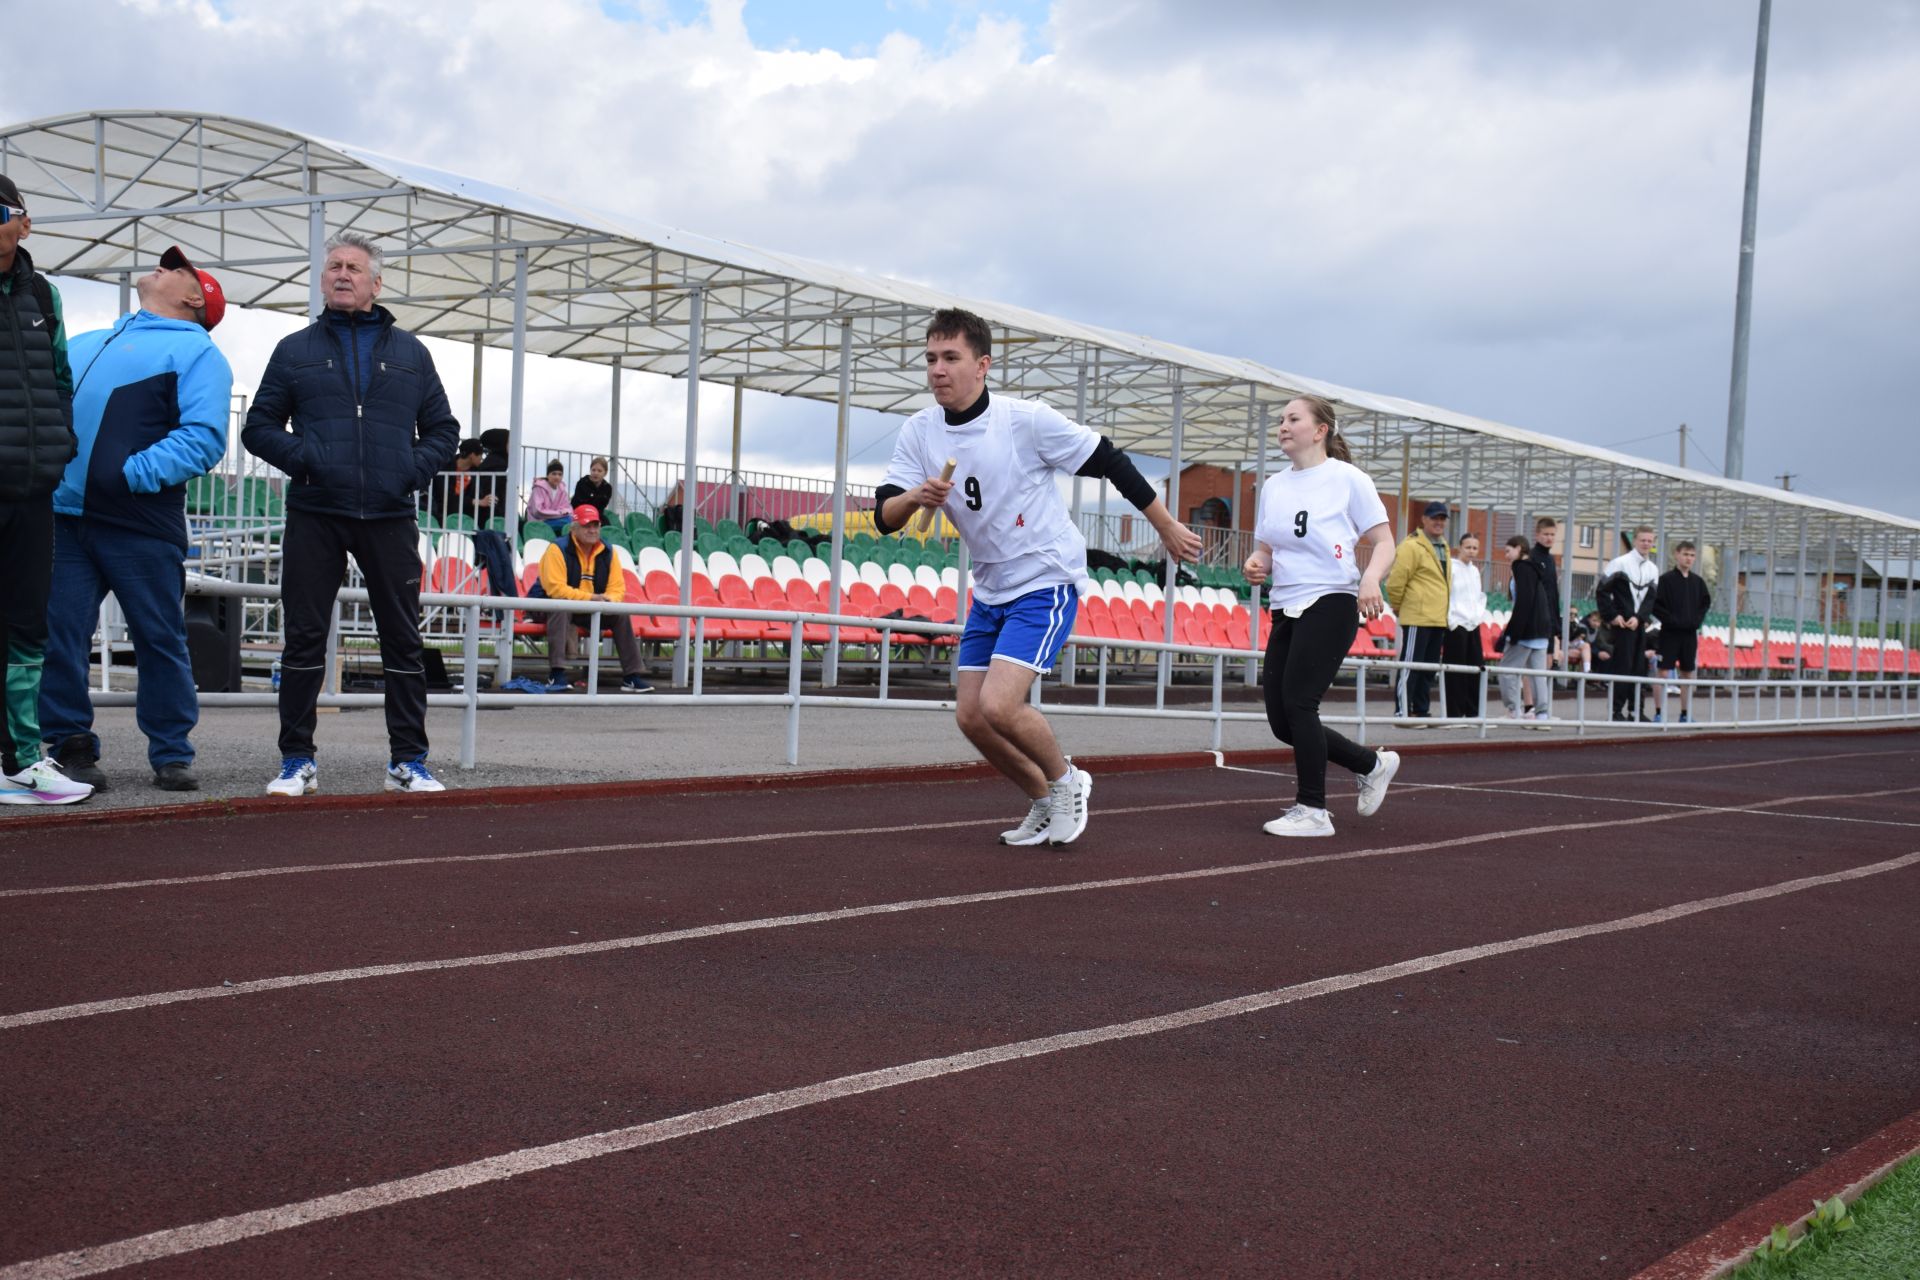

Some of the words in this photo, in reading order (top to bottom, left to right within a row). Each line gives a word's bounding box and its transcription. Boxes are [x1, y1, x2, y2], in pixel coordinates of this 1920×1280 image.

[964, 476, 982, 512] 9
[1016, 513, 1025, 528] 4
[1294, 510, 1308, 538] 9
[1334, 544, 1342, 559] 3
